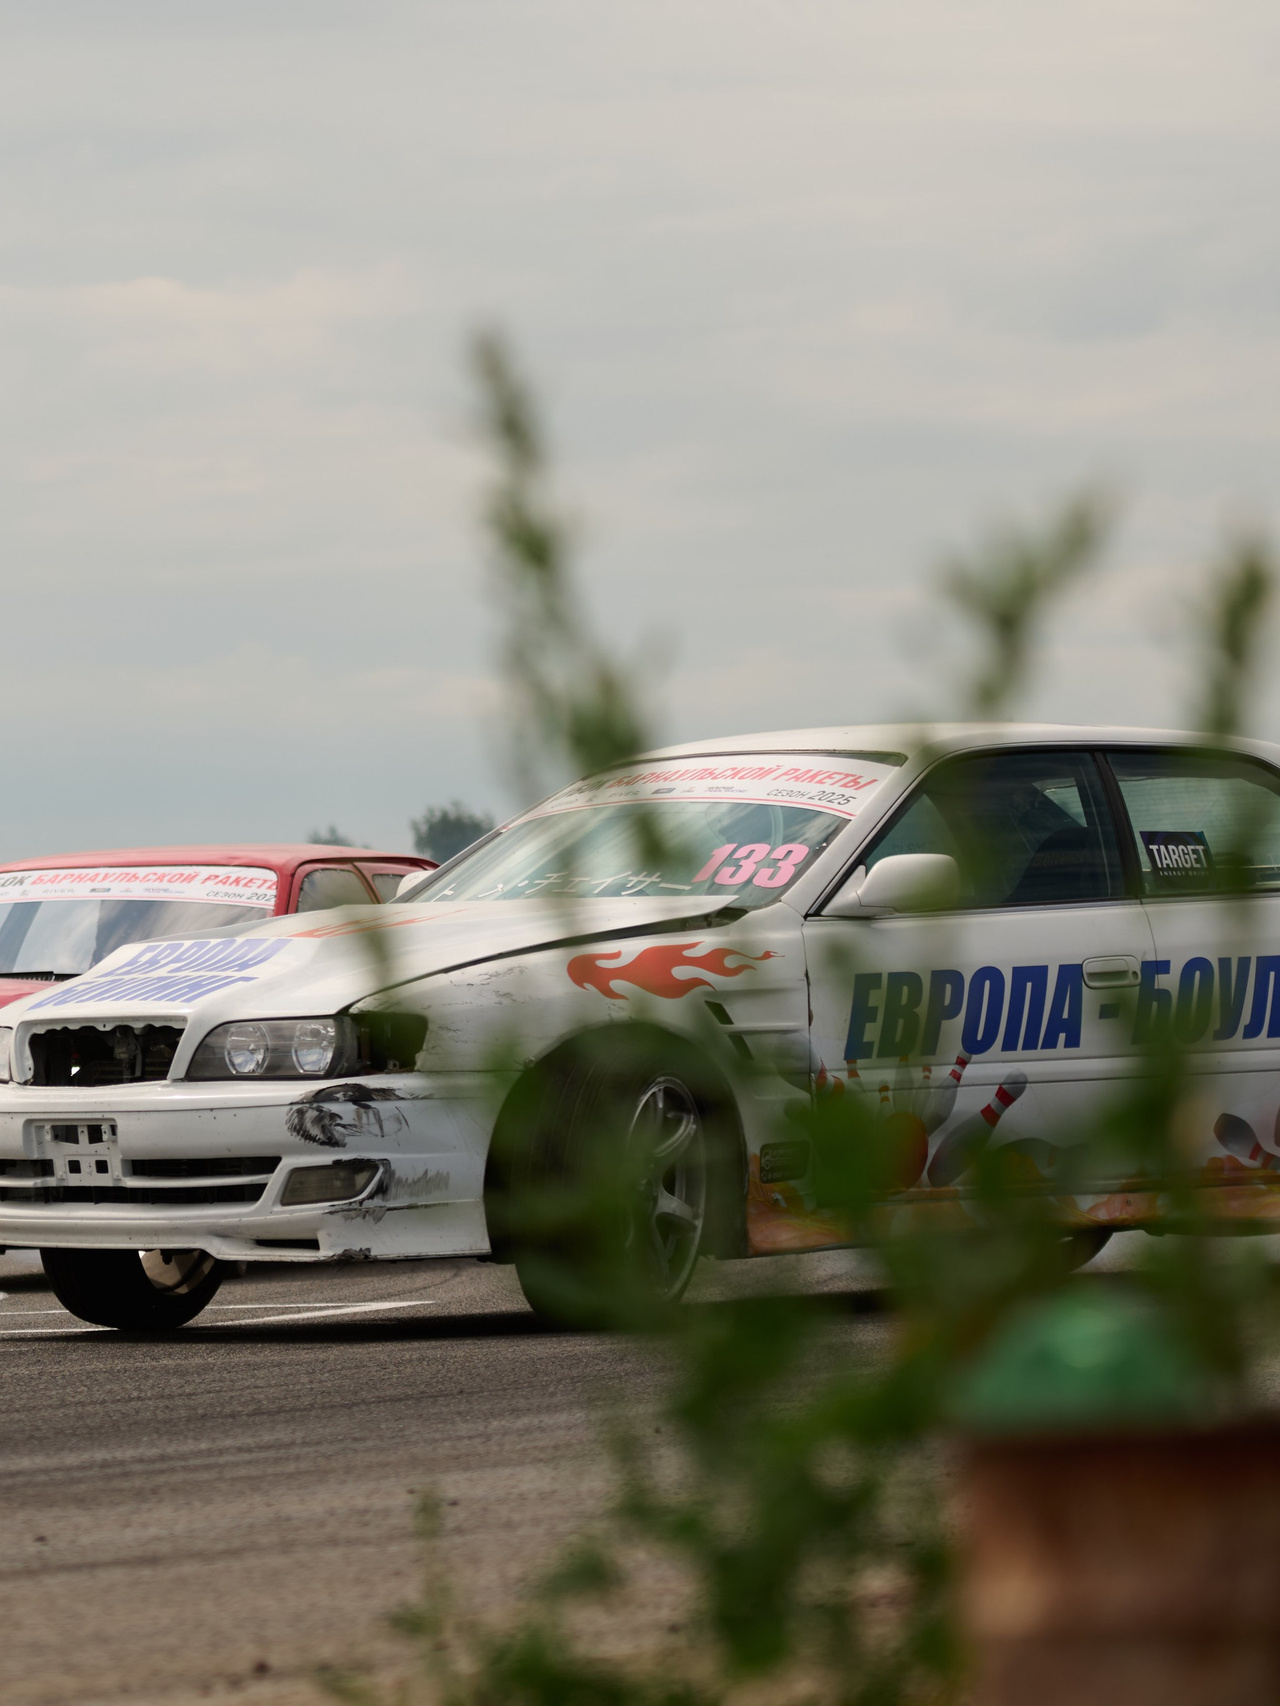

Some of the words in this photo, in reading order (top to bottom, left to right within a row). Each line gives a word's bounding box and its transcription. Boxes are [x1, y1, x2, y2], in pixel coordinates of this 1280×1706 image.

[606, 765, 785, 789] БАРНАУЛЬСКОЙ
[772, 767, 879, 791] РАКЕТЫ
[766, 788, 811, 799] СЕЗОН
[808, 790, 857, 806] 2025
[691, 843, 810, 888] 133
[1149, 845, 1208, 868] TARGET
[30, 871, 200, 886] БАРНАУЛЬСКОЙ
[206, 890, 246, 899] СЕЗОН
[92, 938, 294, 979] ЕВРОПА
[24, 975, 260, 1012] БОУЛИНГ
[843, 963, 1084, 1061] ЕВРОПА
